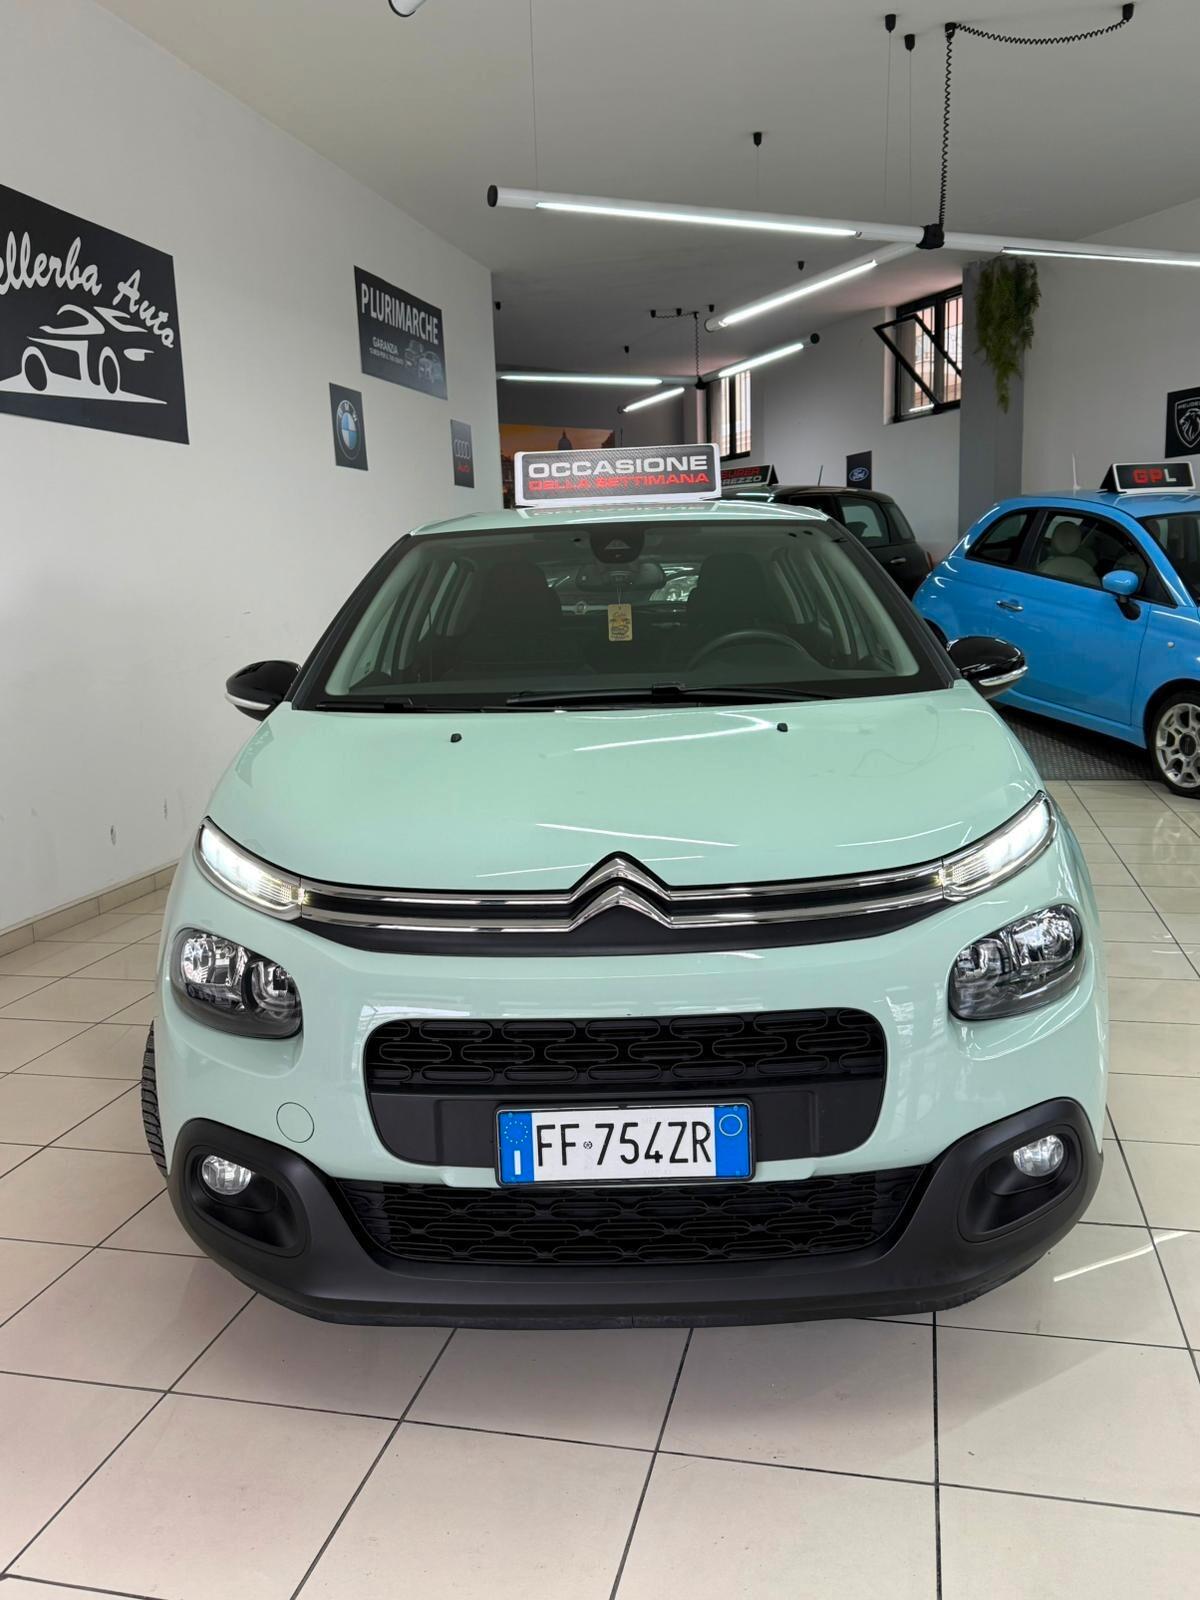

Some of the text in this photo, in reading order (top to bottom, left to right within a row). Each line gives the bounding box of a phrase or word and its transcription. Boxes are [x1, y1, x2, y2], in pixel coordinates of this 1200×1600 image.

[112, 269, 174, 348] Auto
[361, 283, 438, 344] PLURIMARCHE
[528, 455, 708, 478] OCCASIONE
[1133, 468, 1177, 485] GPL
[528, 473, 709, 491] DELLA SETTIMANA
[721, 475, 762, 486] REZZO
[536, 1123, 580, 1167] FF
[595, 1121, 712, 1165] 754ZR
